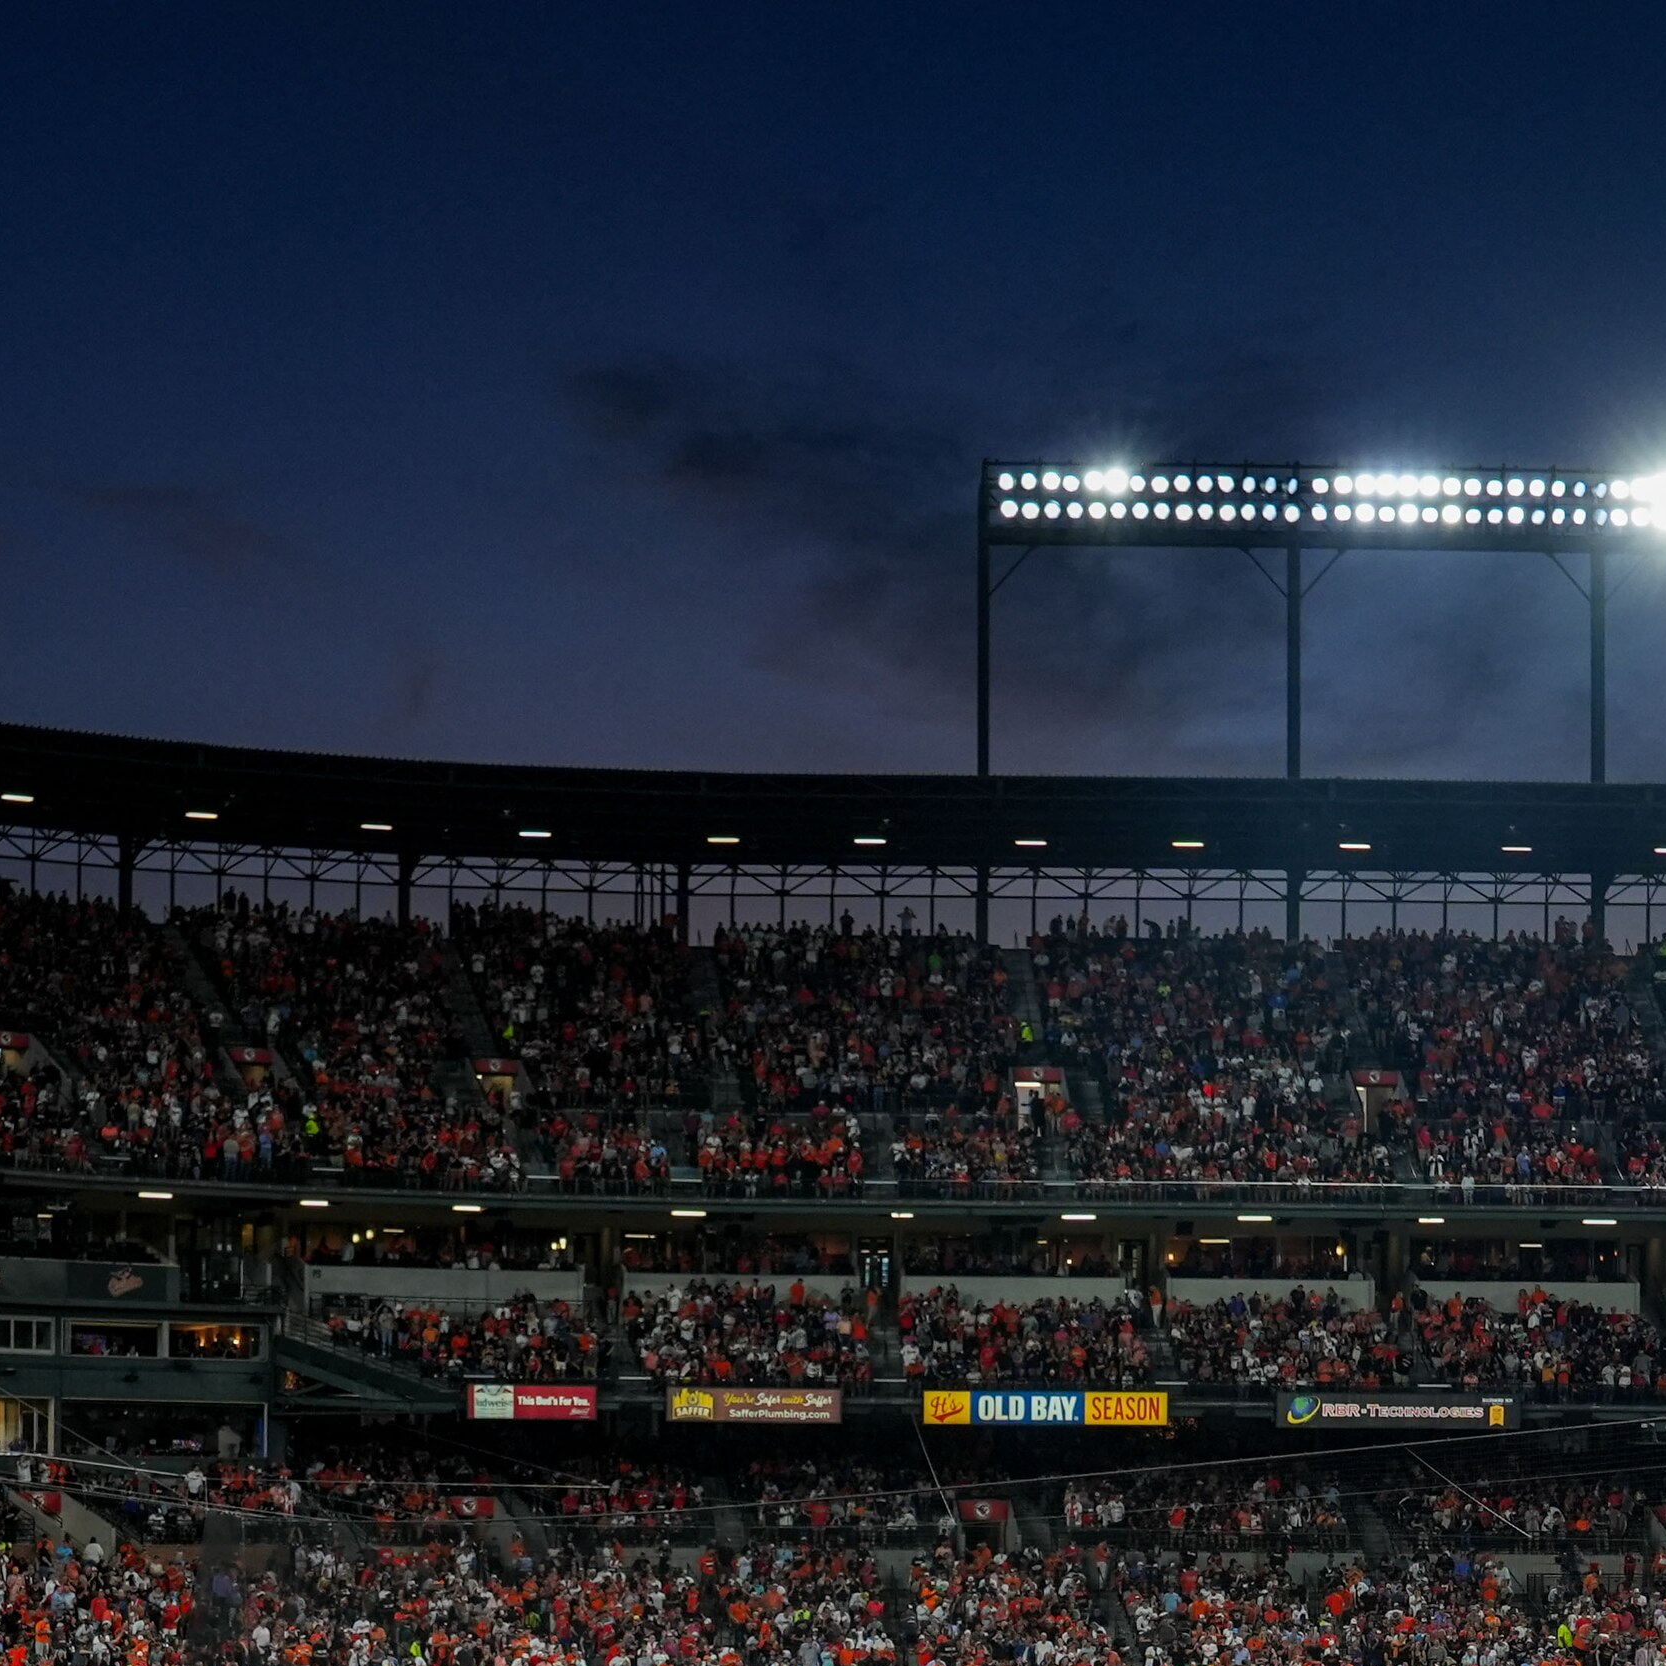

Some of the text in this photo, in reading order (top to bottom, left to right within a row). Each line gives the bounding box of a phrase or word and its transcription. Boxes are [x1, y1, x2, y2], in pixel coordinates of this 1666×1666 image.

[517, 1396, 590, 1406] This Bud's For You.
[723, 1392, 833, 1407] You're Safer with Saffer
[930, 1393, 964, 1421] It's
[676, 1407, 710, 1418] SAFFER
[729, 1409, 830, 1421] SafferPlumbing.com
[977, 1395, 1025, 1421] OLD
[1092, 1397, 1160, 1420] SEASON
